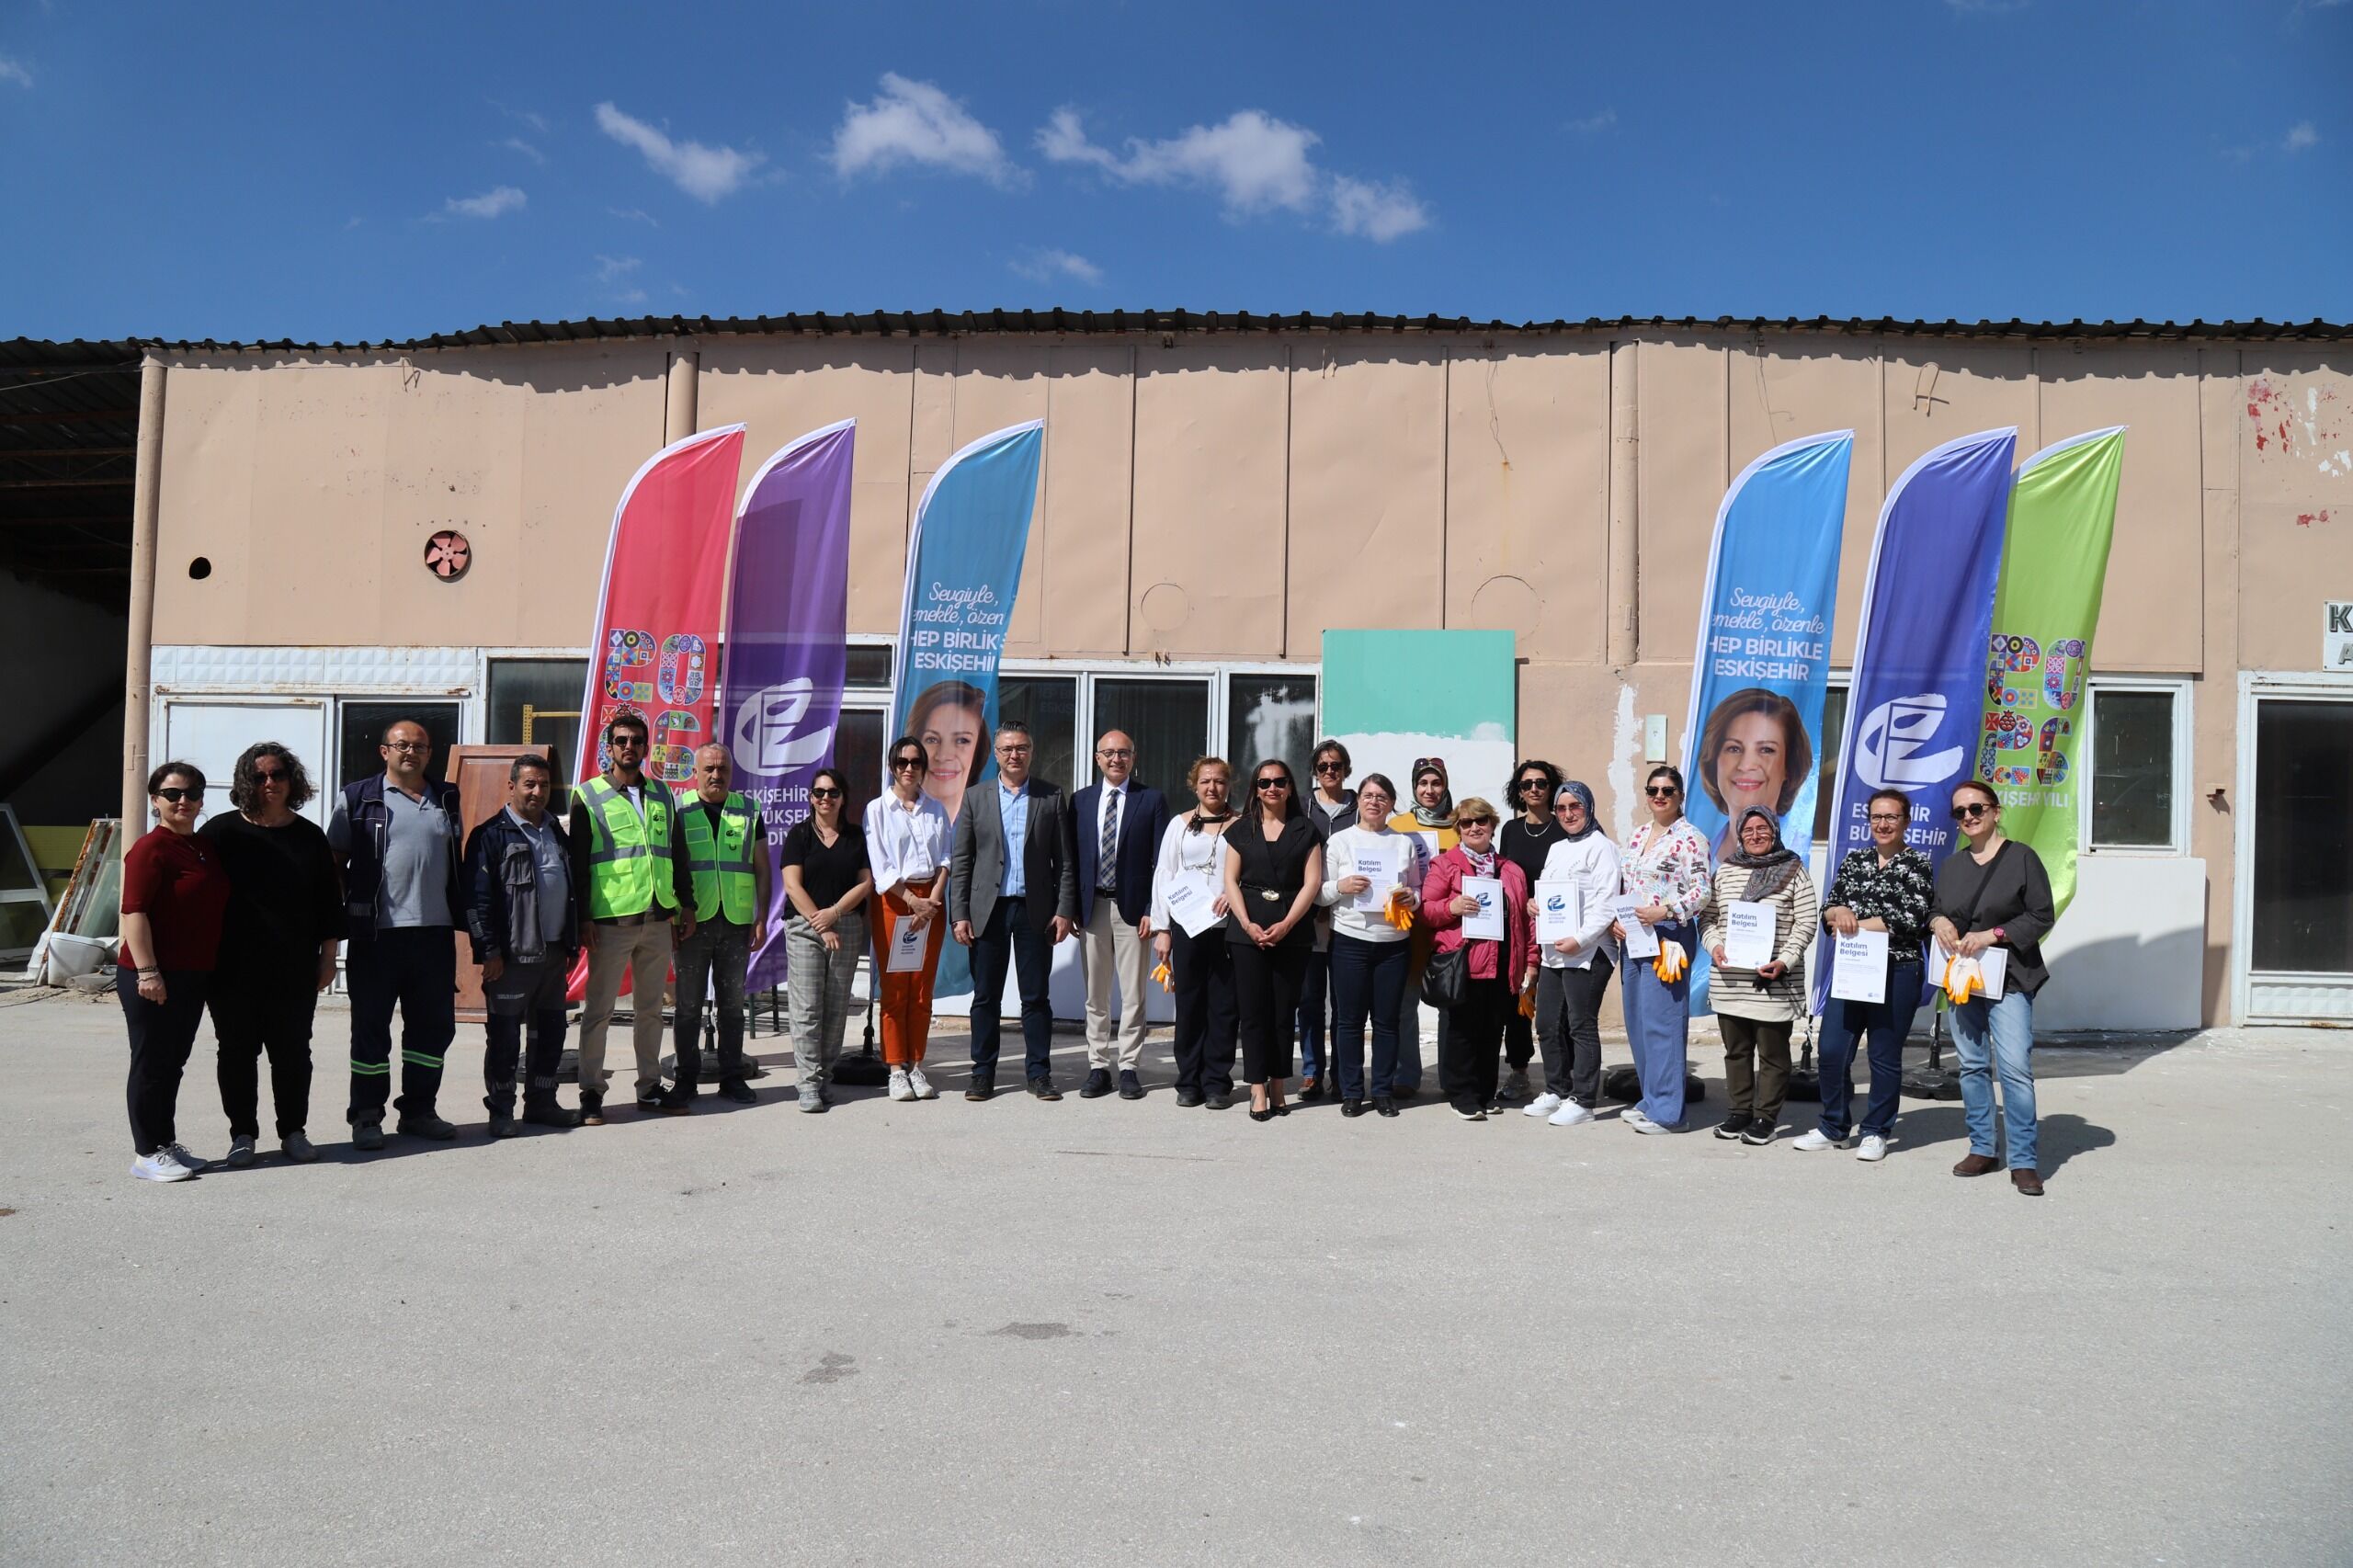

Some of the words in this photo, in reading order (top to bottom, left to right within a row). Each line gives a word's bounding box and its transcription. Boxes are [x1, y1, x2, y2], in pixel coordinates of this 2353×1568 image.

[928, 582, 998, 609] Sevgiyle,
[1730, 587, 1805, 616] Sevgiyle,
[967, 608, 1005, 625] özen
[1771, 614, 1825, 634] özenle
[943, 628, 1007, 651] BİRLİK
[1745, 634, 1824, 660] BİRLİKLE
[1714, 656, 1809, 681] ESKİŞEHİR
[735, 785, 809, 805] SKİŞEHİR
